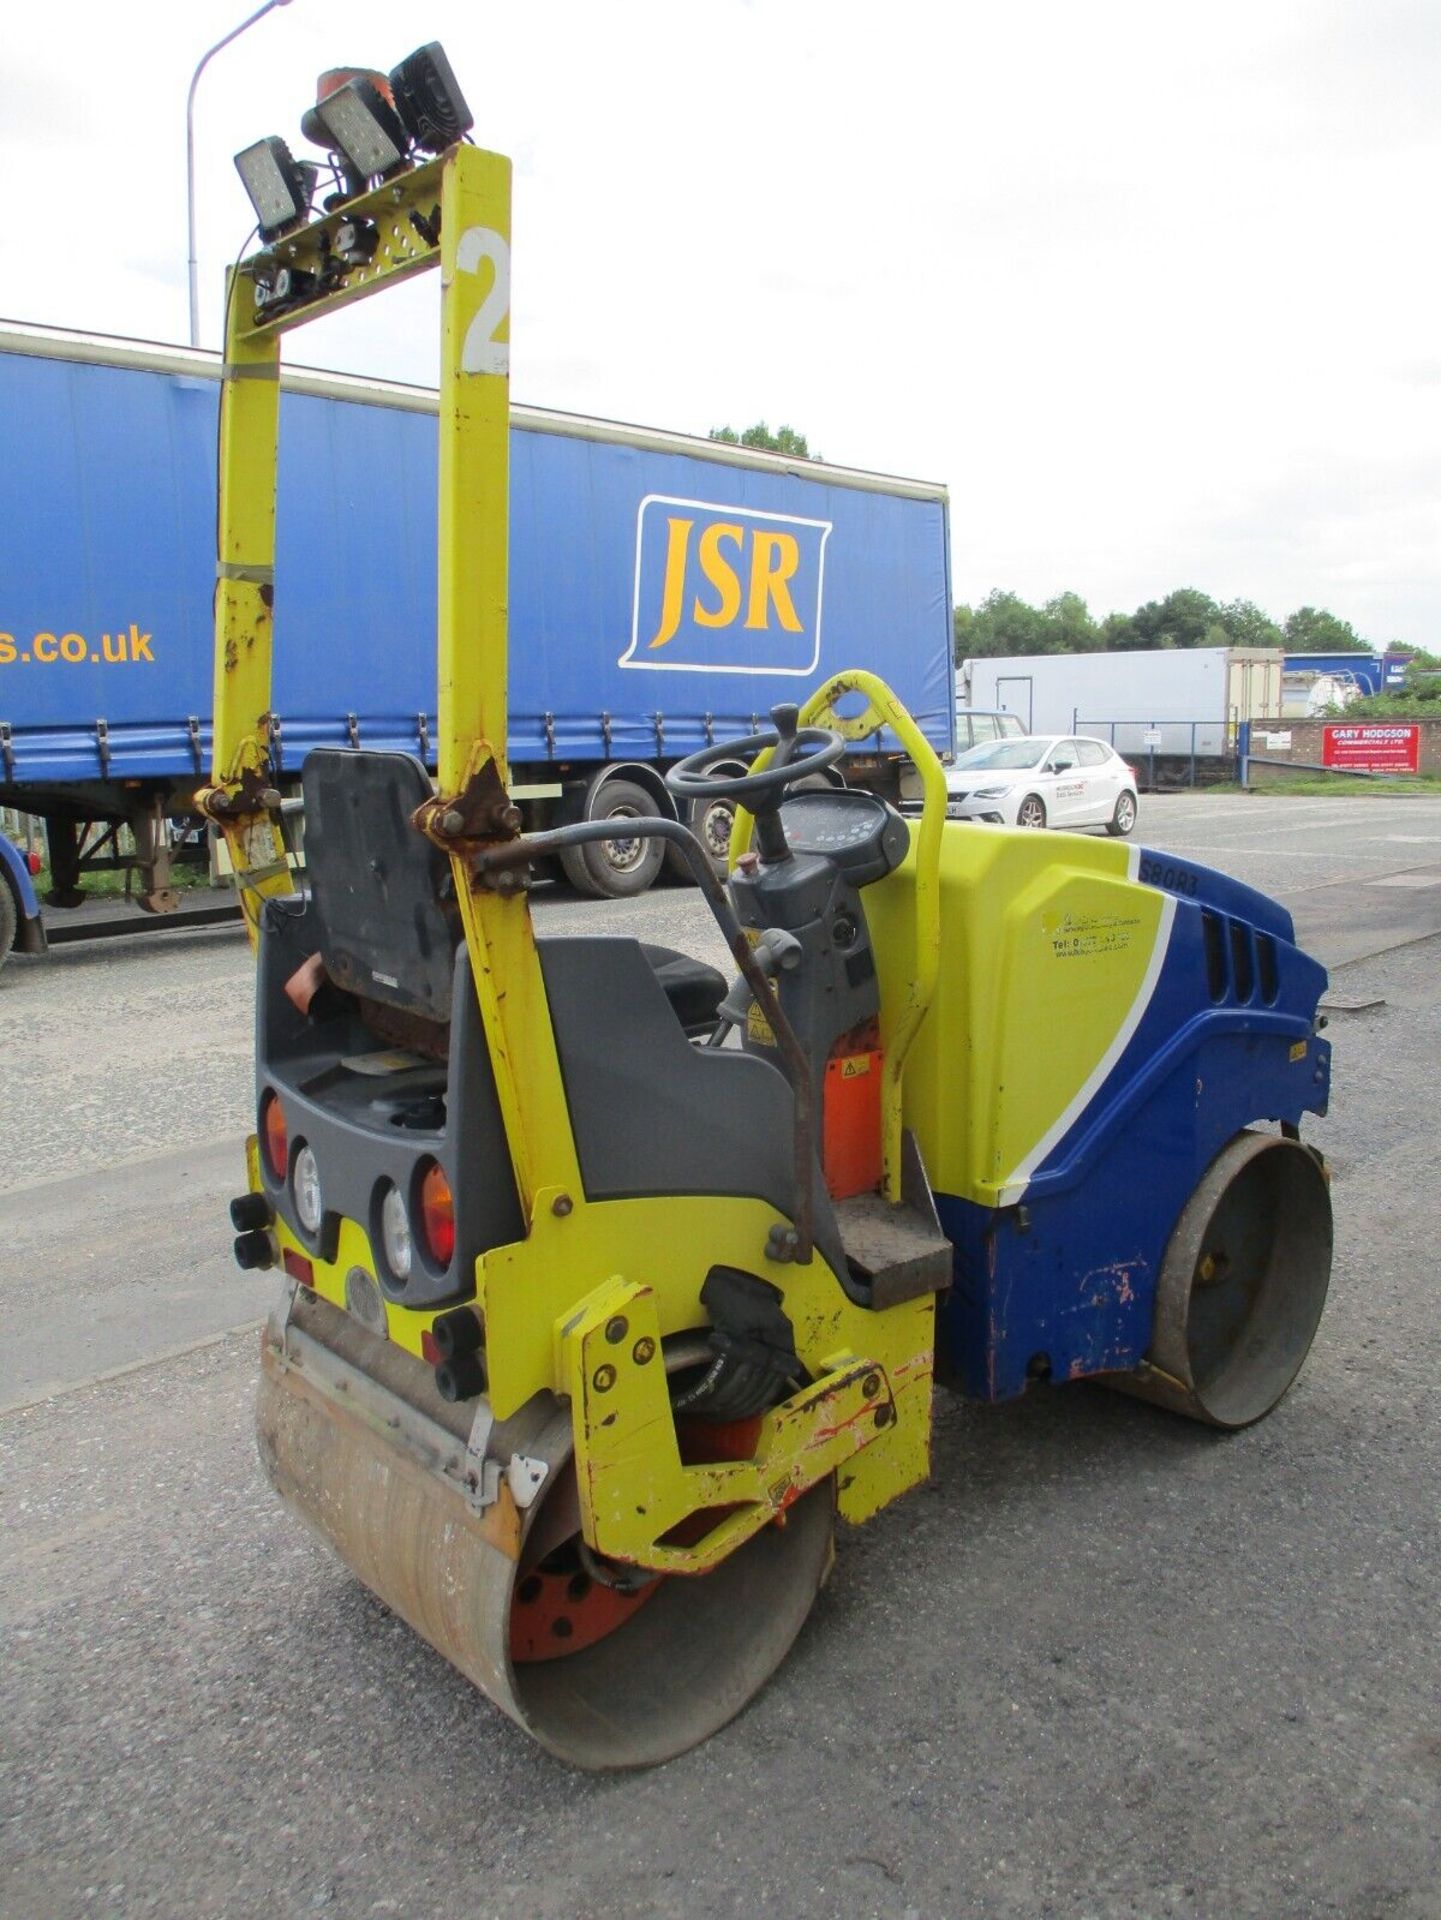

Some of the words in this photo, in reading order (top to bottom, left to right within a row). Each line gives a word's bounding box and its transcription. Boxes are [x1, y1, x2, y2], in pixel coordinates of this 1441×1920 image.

[456, 226, 510, 375] 2
[648, 518, 804, 649] JSR
[1332, 729, 1360, 738] GARY
[1362, 729, 1411, 738] HODGSON
